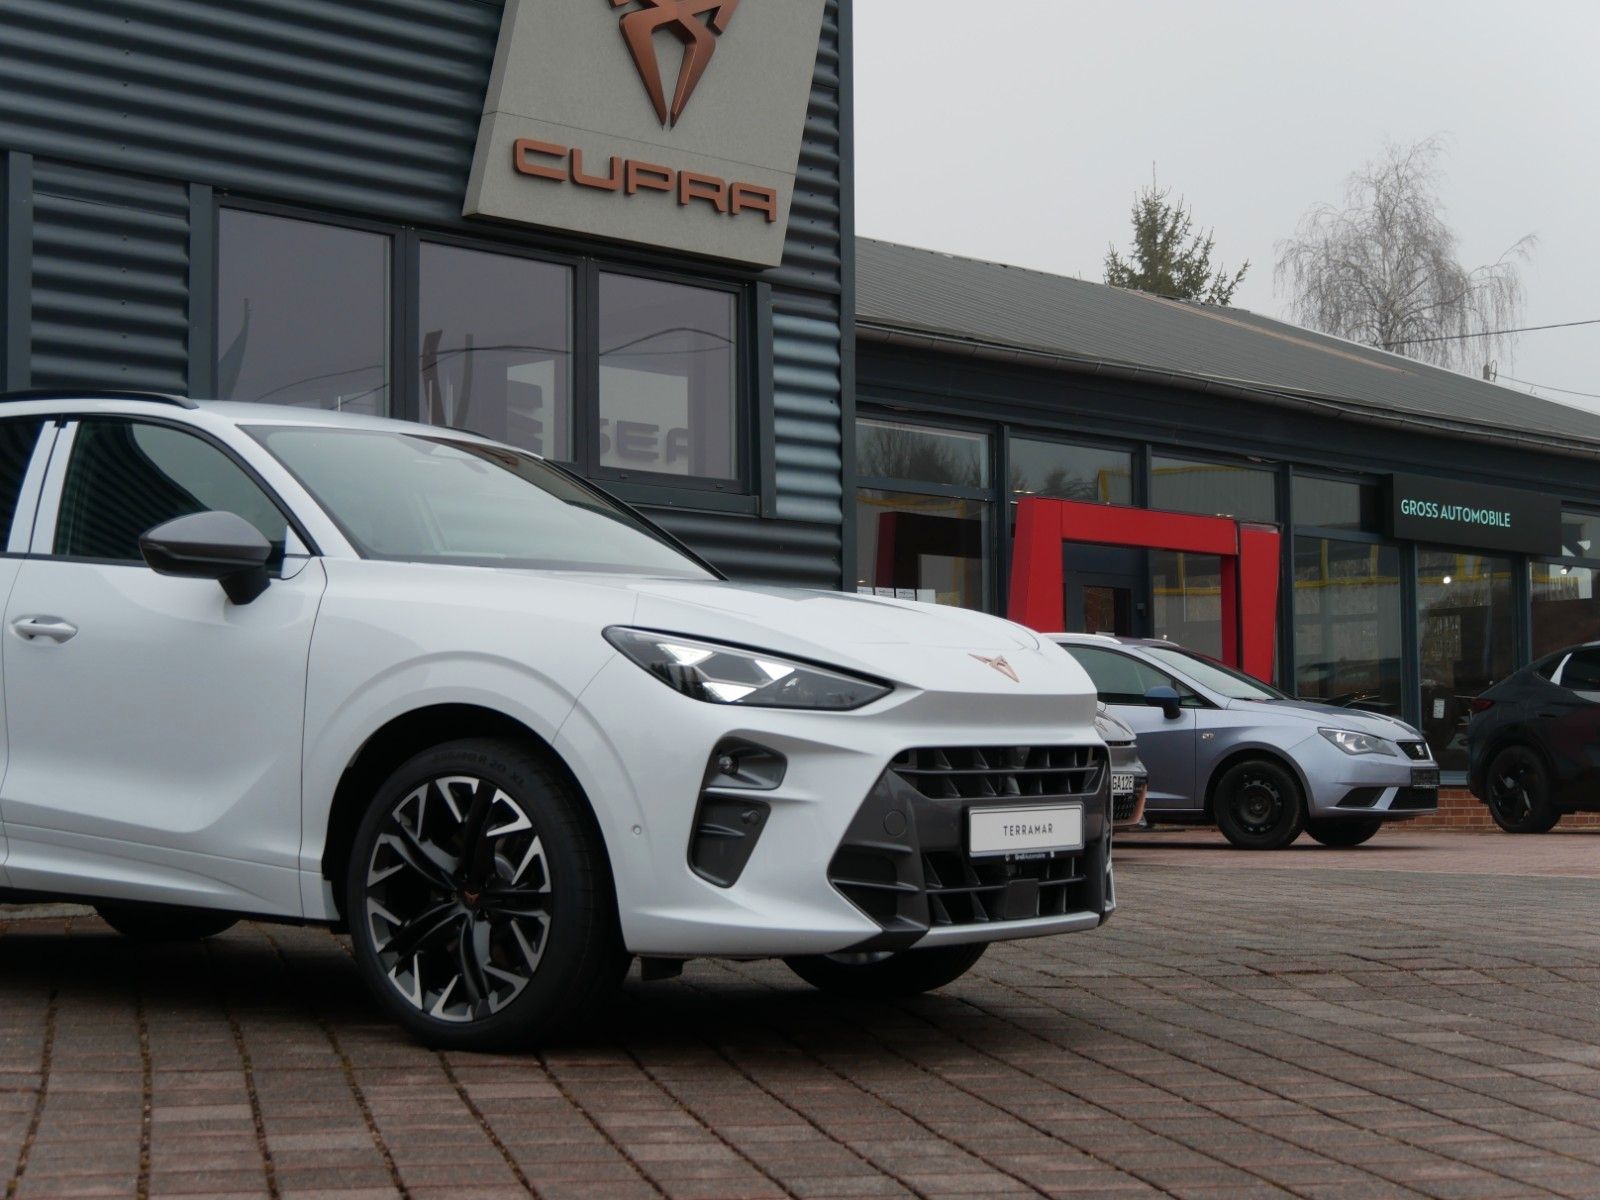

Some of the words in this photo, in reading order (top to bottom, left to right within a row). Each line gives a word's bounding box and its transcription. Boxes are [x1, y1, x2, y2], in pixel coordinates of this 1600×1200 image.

[513, 138, 777, 222] CUPRA
[1401, 499, 1438, 518] GROSS
[1440, 505, 1511, 527] AUTOMOBILE
[1003, 823, 1053, 837] TERRAMAR
